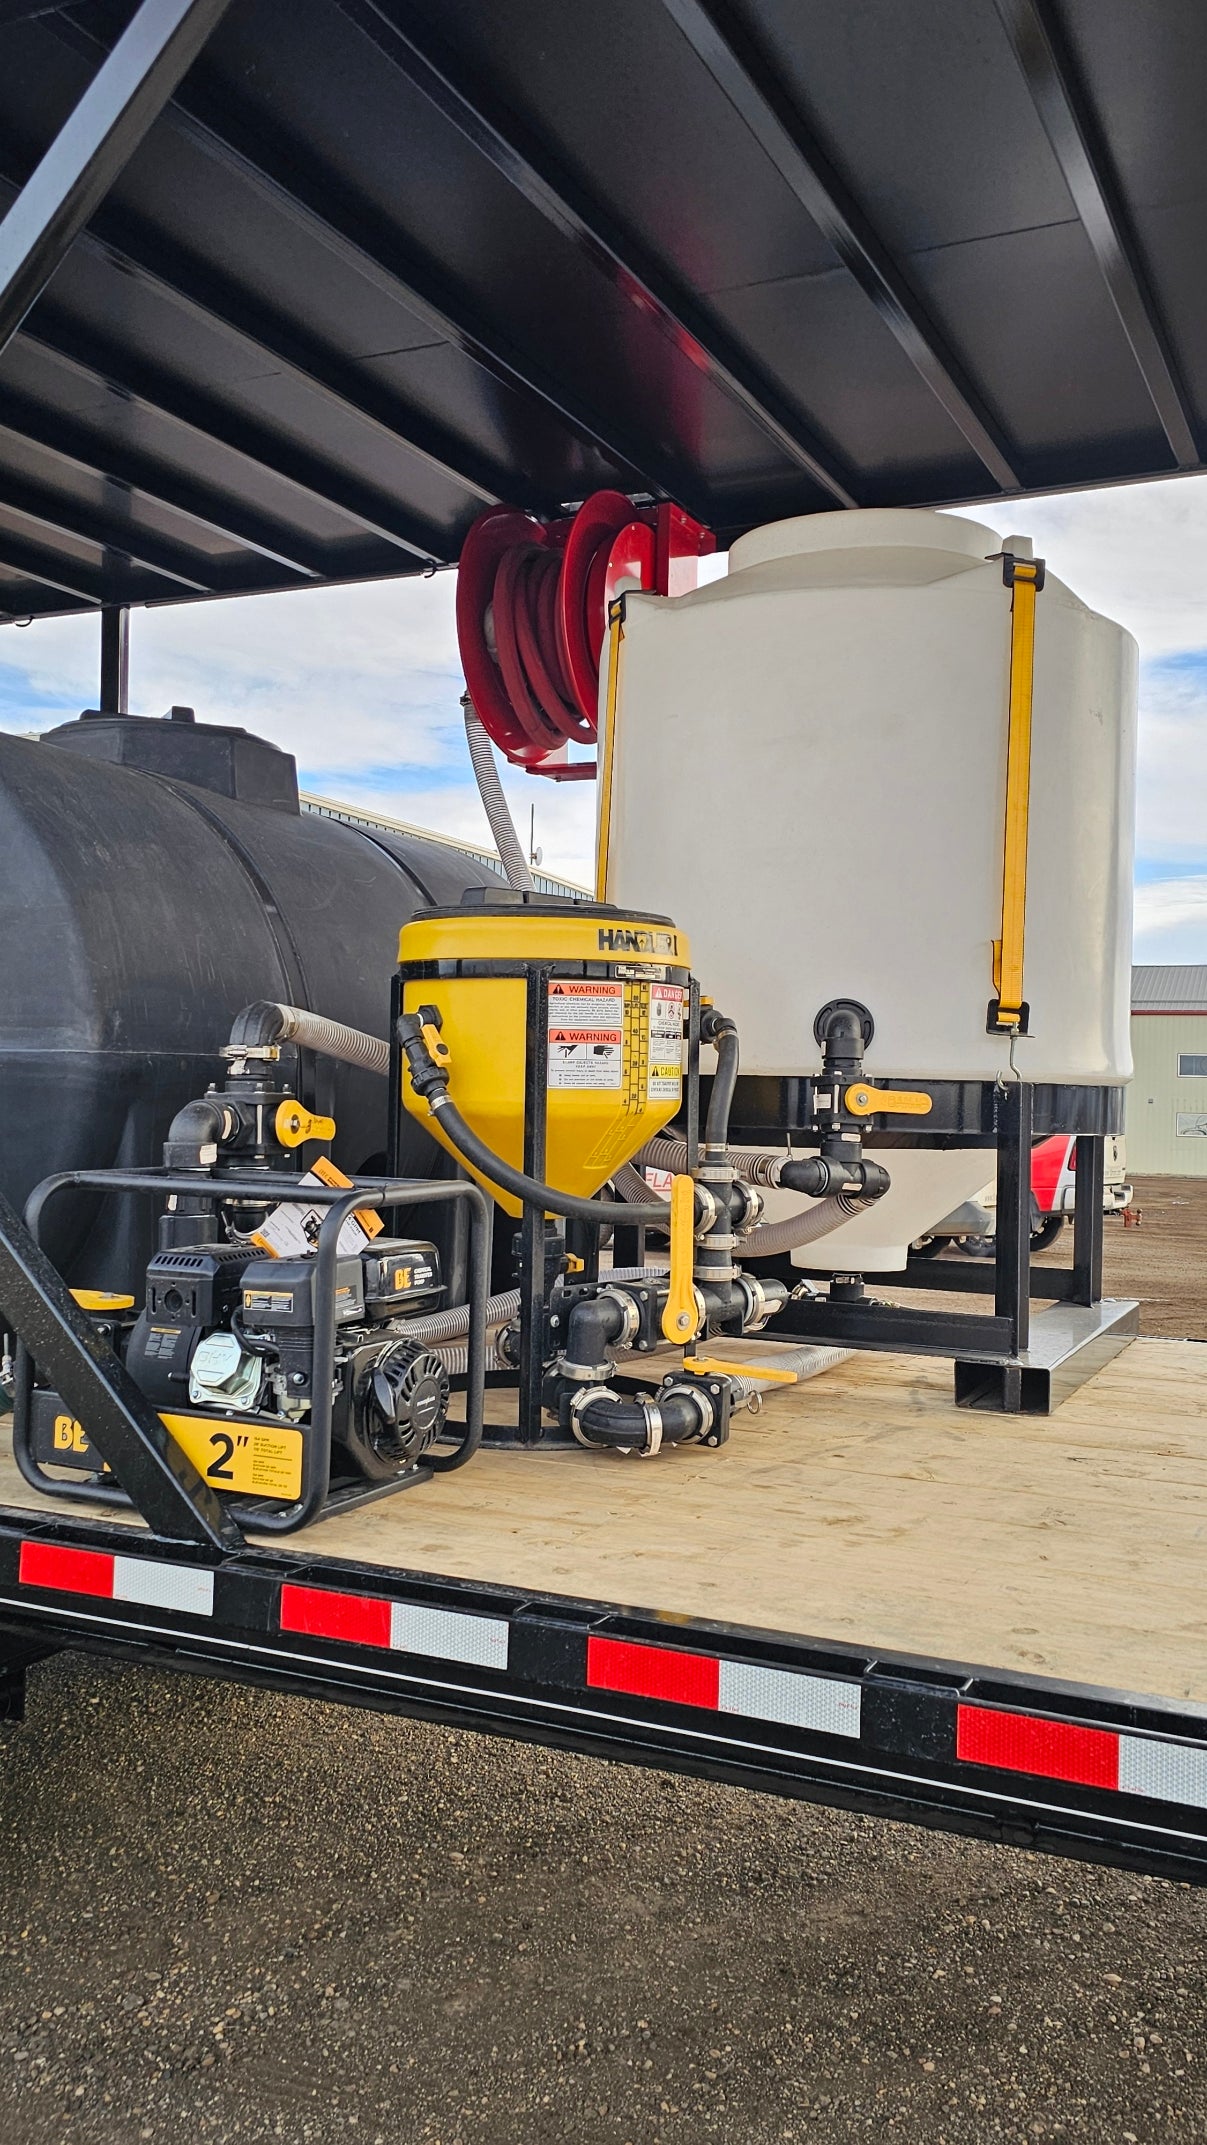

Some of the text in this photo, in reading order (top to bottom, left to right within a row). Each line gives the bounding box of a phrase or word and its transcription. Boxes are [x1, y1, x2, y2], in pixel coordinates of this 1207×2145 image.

[568, 985, 616, 995] WARNING
[569, 1032, 617, 1042] WARNING
[395, 1267, 411, 1290] BE
[54, 1415, 89, 1453] BE
